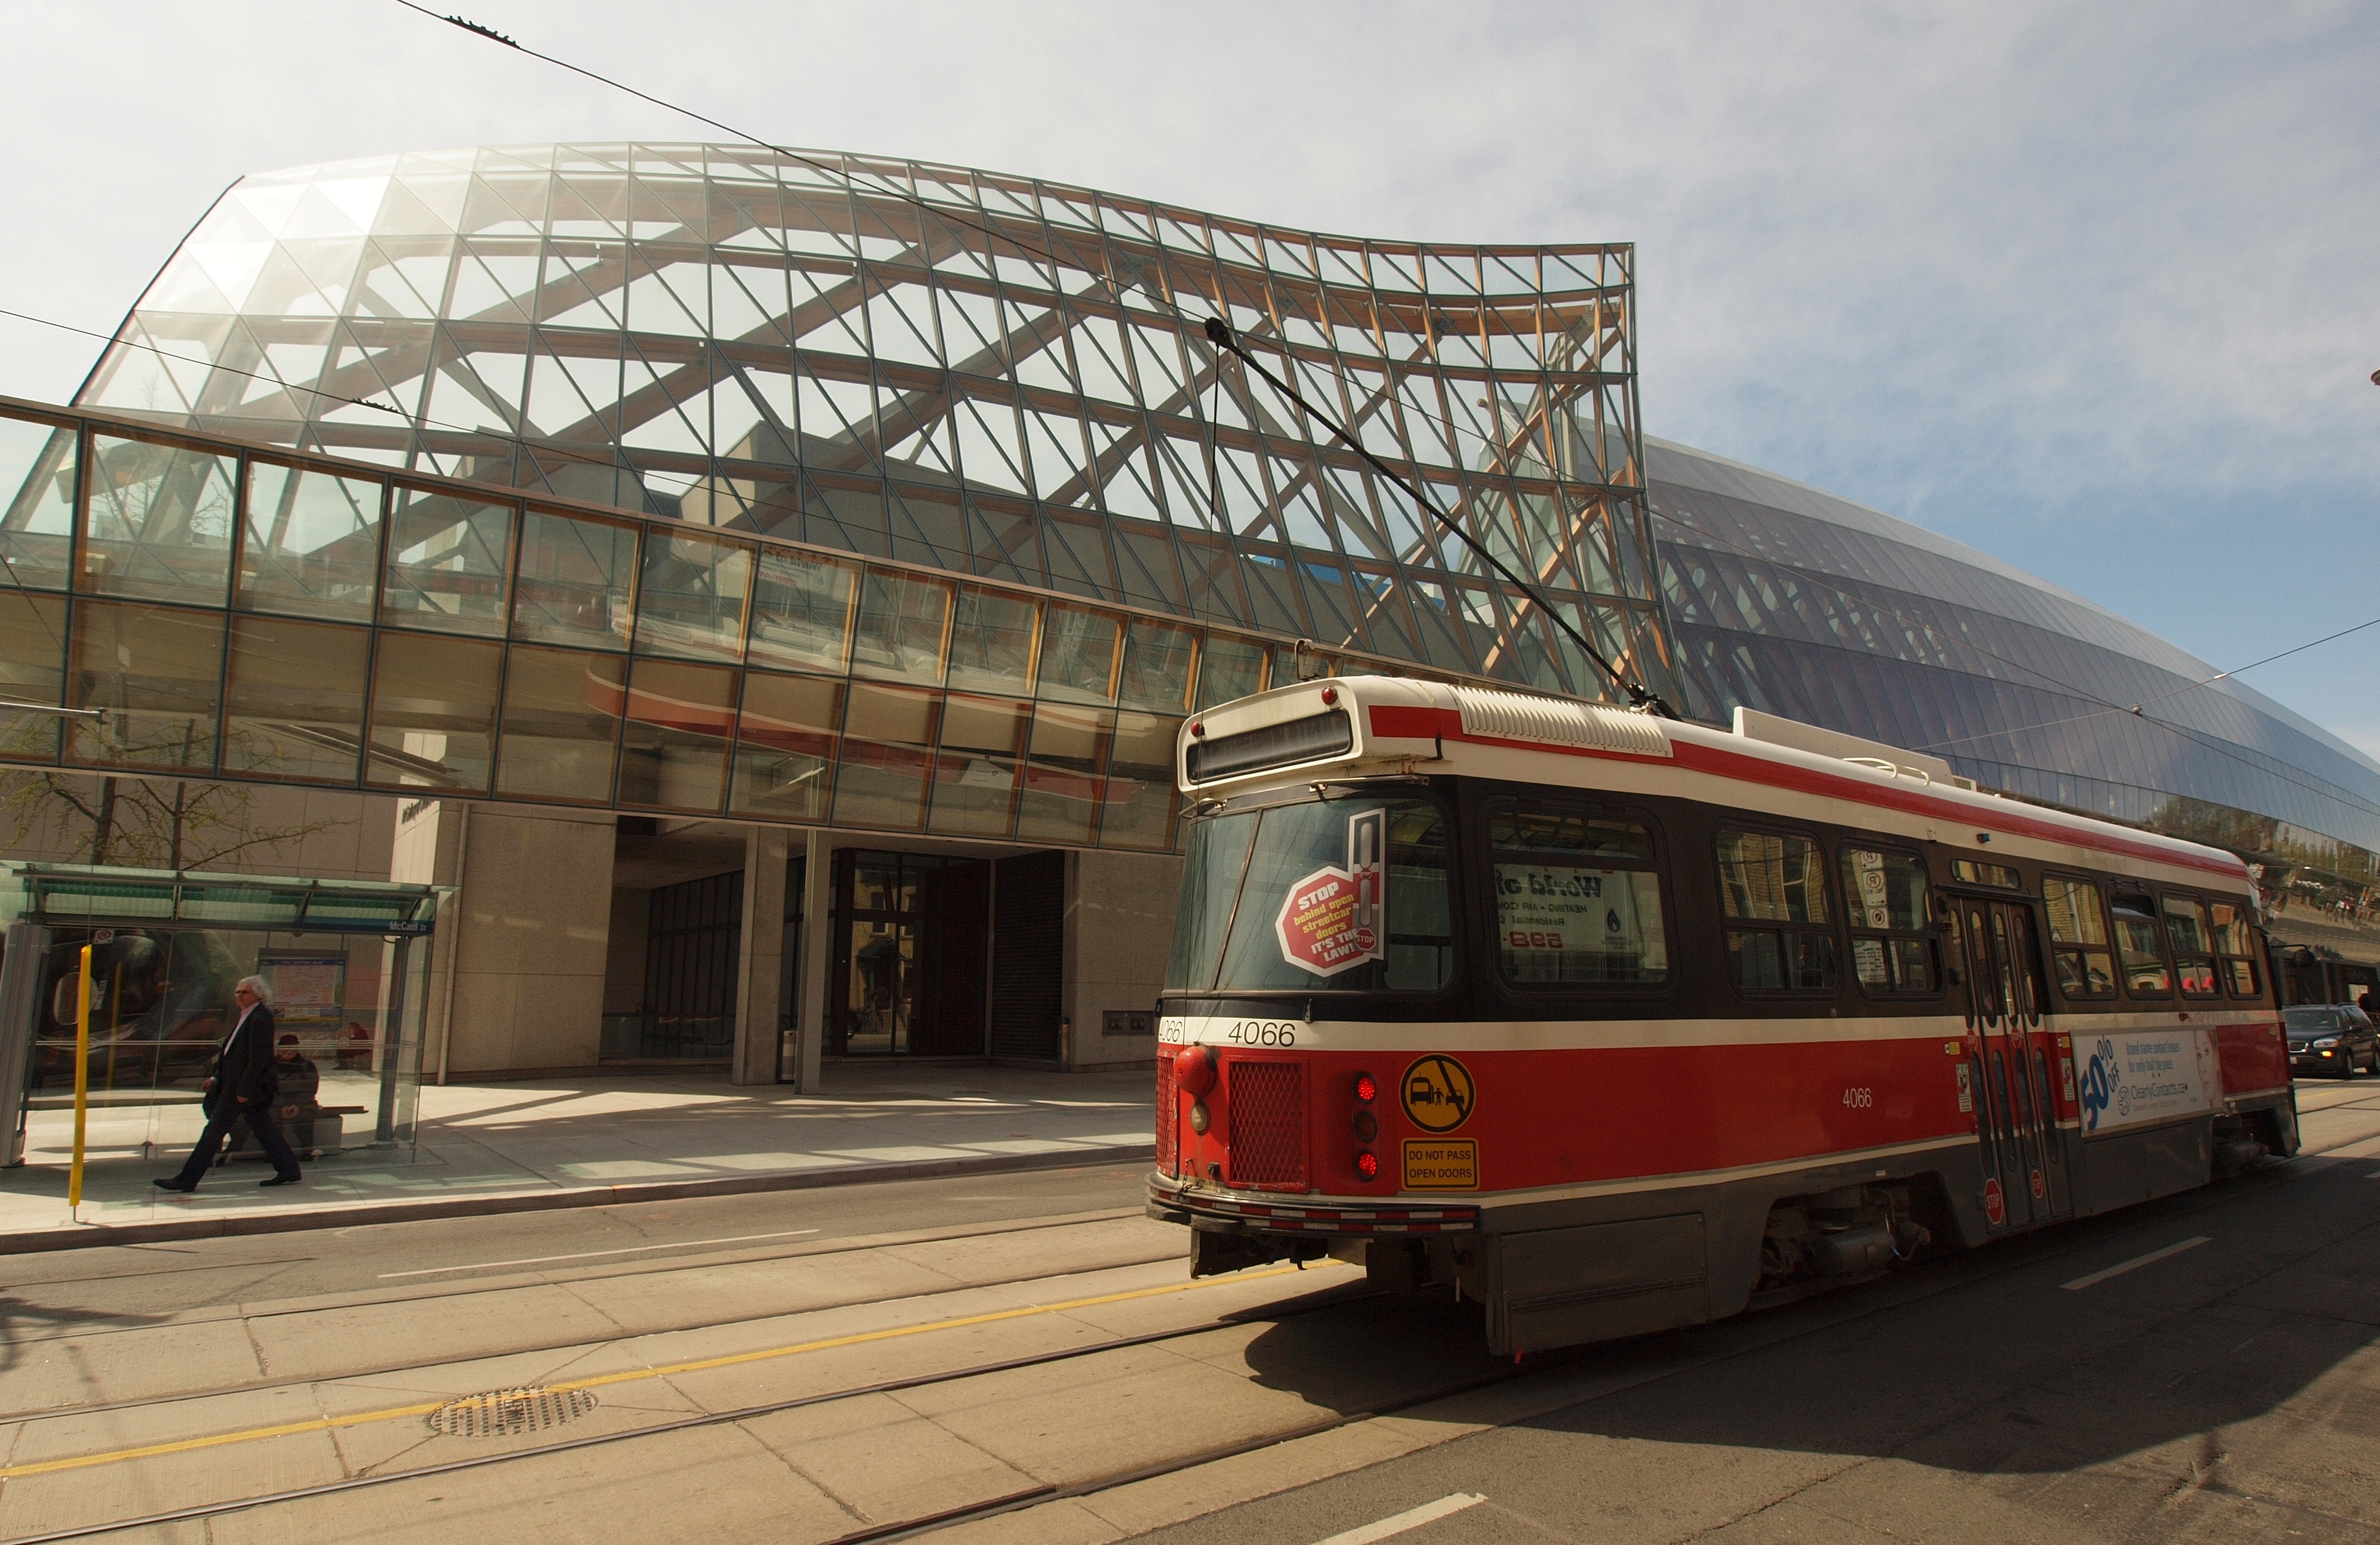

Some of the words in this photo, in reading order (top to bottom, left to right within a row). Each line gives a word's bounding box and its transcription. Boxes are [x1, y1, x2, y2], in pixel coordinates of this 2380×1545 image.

[1297, 881, 1340, 911] STOP
[1293, 904, 1327, 926] behind
[1329, 894, 1355, 909] open
[390, 921, 419, 930] McCaul
[1303, 906, 1352, 934] streetcar
[1316, 922, 1347, 940] doors
[1356, 935, 1374, 943] STOP
[1311, 937, 1335, 954] IT'S
[1323, 942, 1356, 962] LAW!
[1228, 1021, 1296, 1047] 4066
[2107, 1062, 2120, 1093] OFF
[1843, 1087, 1871, 1108] 4066
[1409, 1150, 1423, 1160] DO
[1426, 1150, 1444, 1160] NOT
[1447, 1150, 1471, 1160] PASS
[1409, 1169, 1436, 1179] OPEN
[1438, 1169, 1472, 1179] DOORS
[1987, 1193, 2000, 1209] STOP
